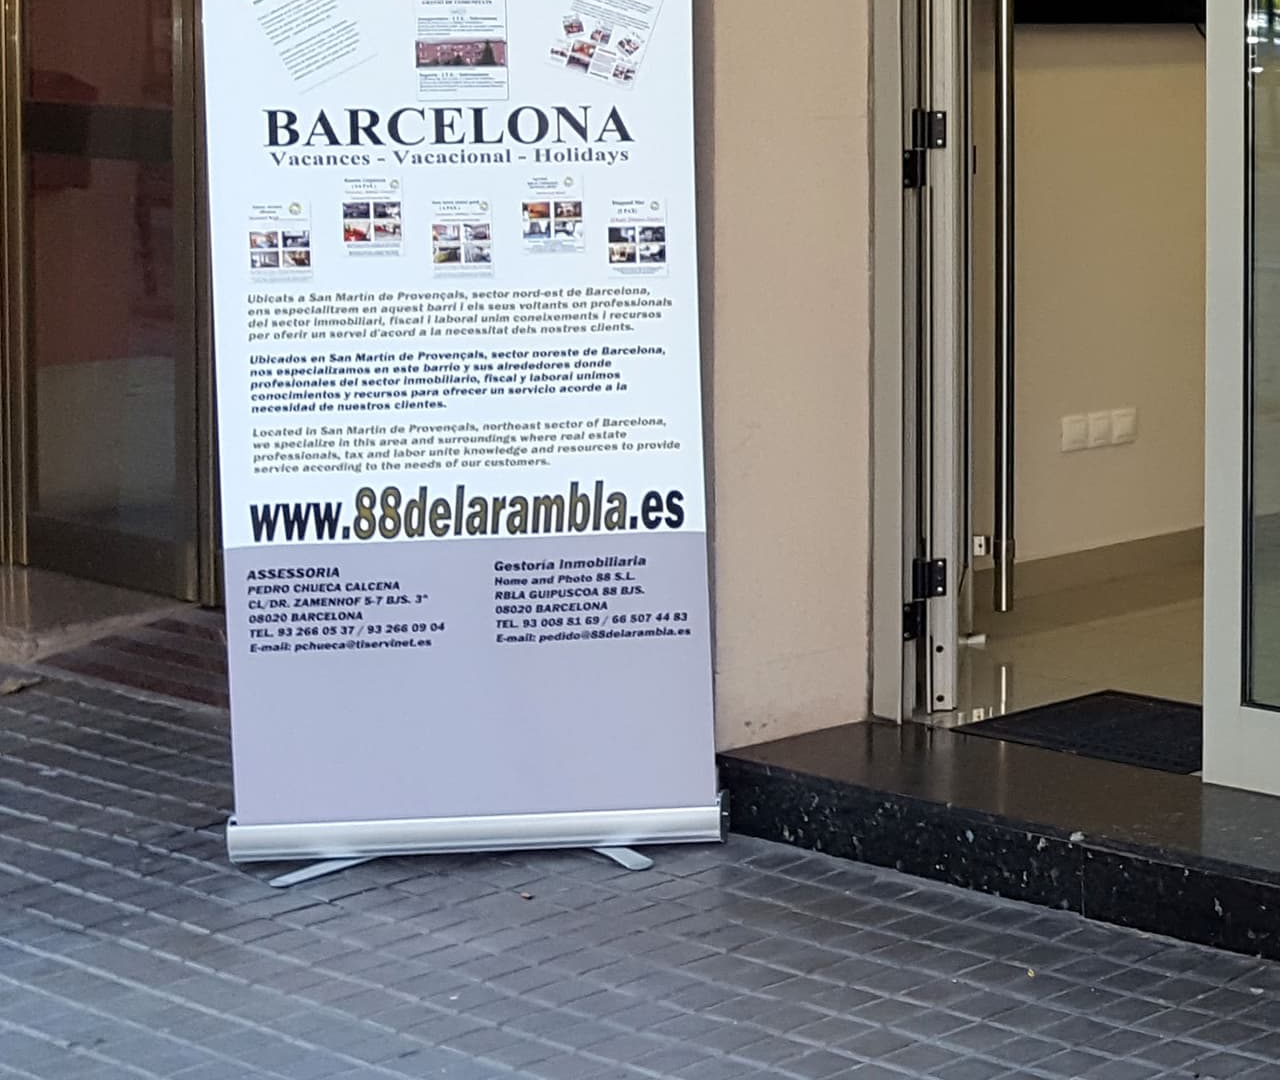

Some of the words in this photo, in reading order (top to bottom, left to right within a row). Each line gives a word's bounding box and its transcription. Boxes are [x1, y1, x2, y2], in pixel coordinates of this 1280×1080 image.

[262, 105, 635, 147] BARCELONA
[270, 151, 371, 167] Vacances
[392, 148, 512, 166] Vacacional
[533, 147, 630, 166] Holidays
[601, 345, 666, 358] Barcelona,
[250, 481, 686, 542] www.88delarambla.es
[559, 555, 646, 570] Inmobiliaria
[247, 567, 340, 580] ASSESSORIA
[247, 584, 290, 595] PEDRO
[293, 583, 342, 593] CHUECA
[345, 581, 400, 592] CALCENA
[495, 590, 526, 600] RBLA
[529, 587, 599, 599] GUIPUSCOA
[602, 586, 617, 596] 88
[495, 605, 532, 614] 08020
[535, 601, 608, 613] BARCELONA
[248, 613, 288, 624] 08020
[291, 611, 363, 622] BARCELONA
